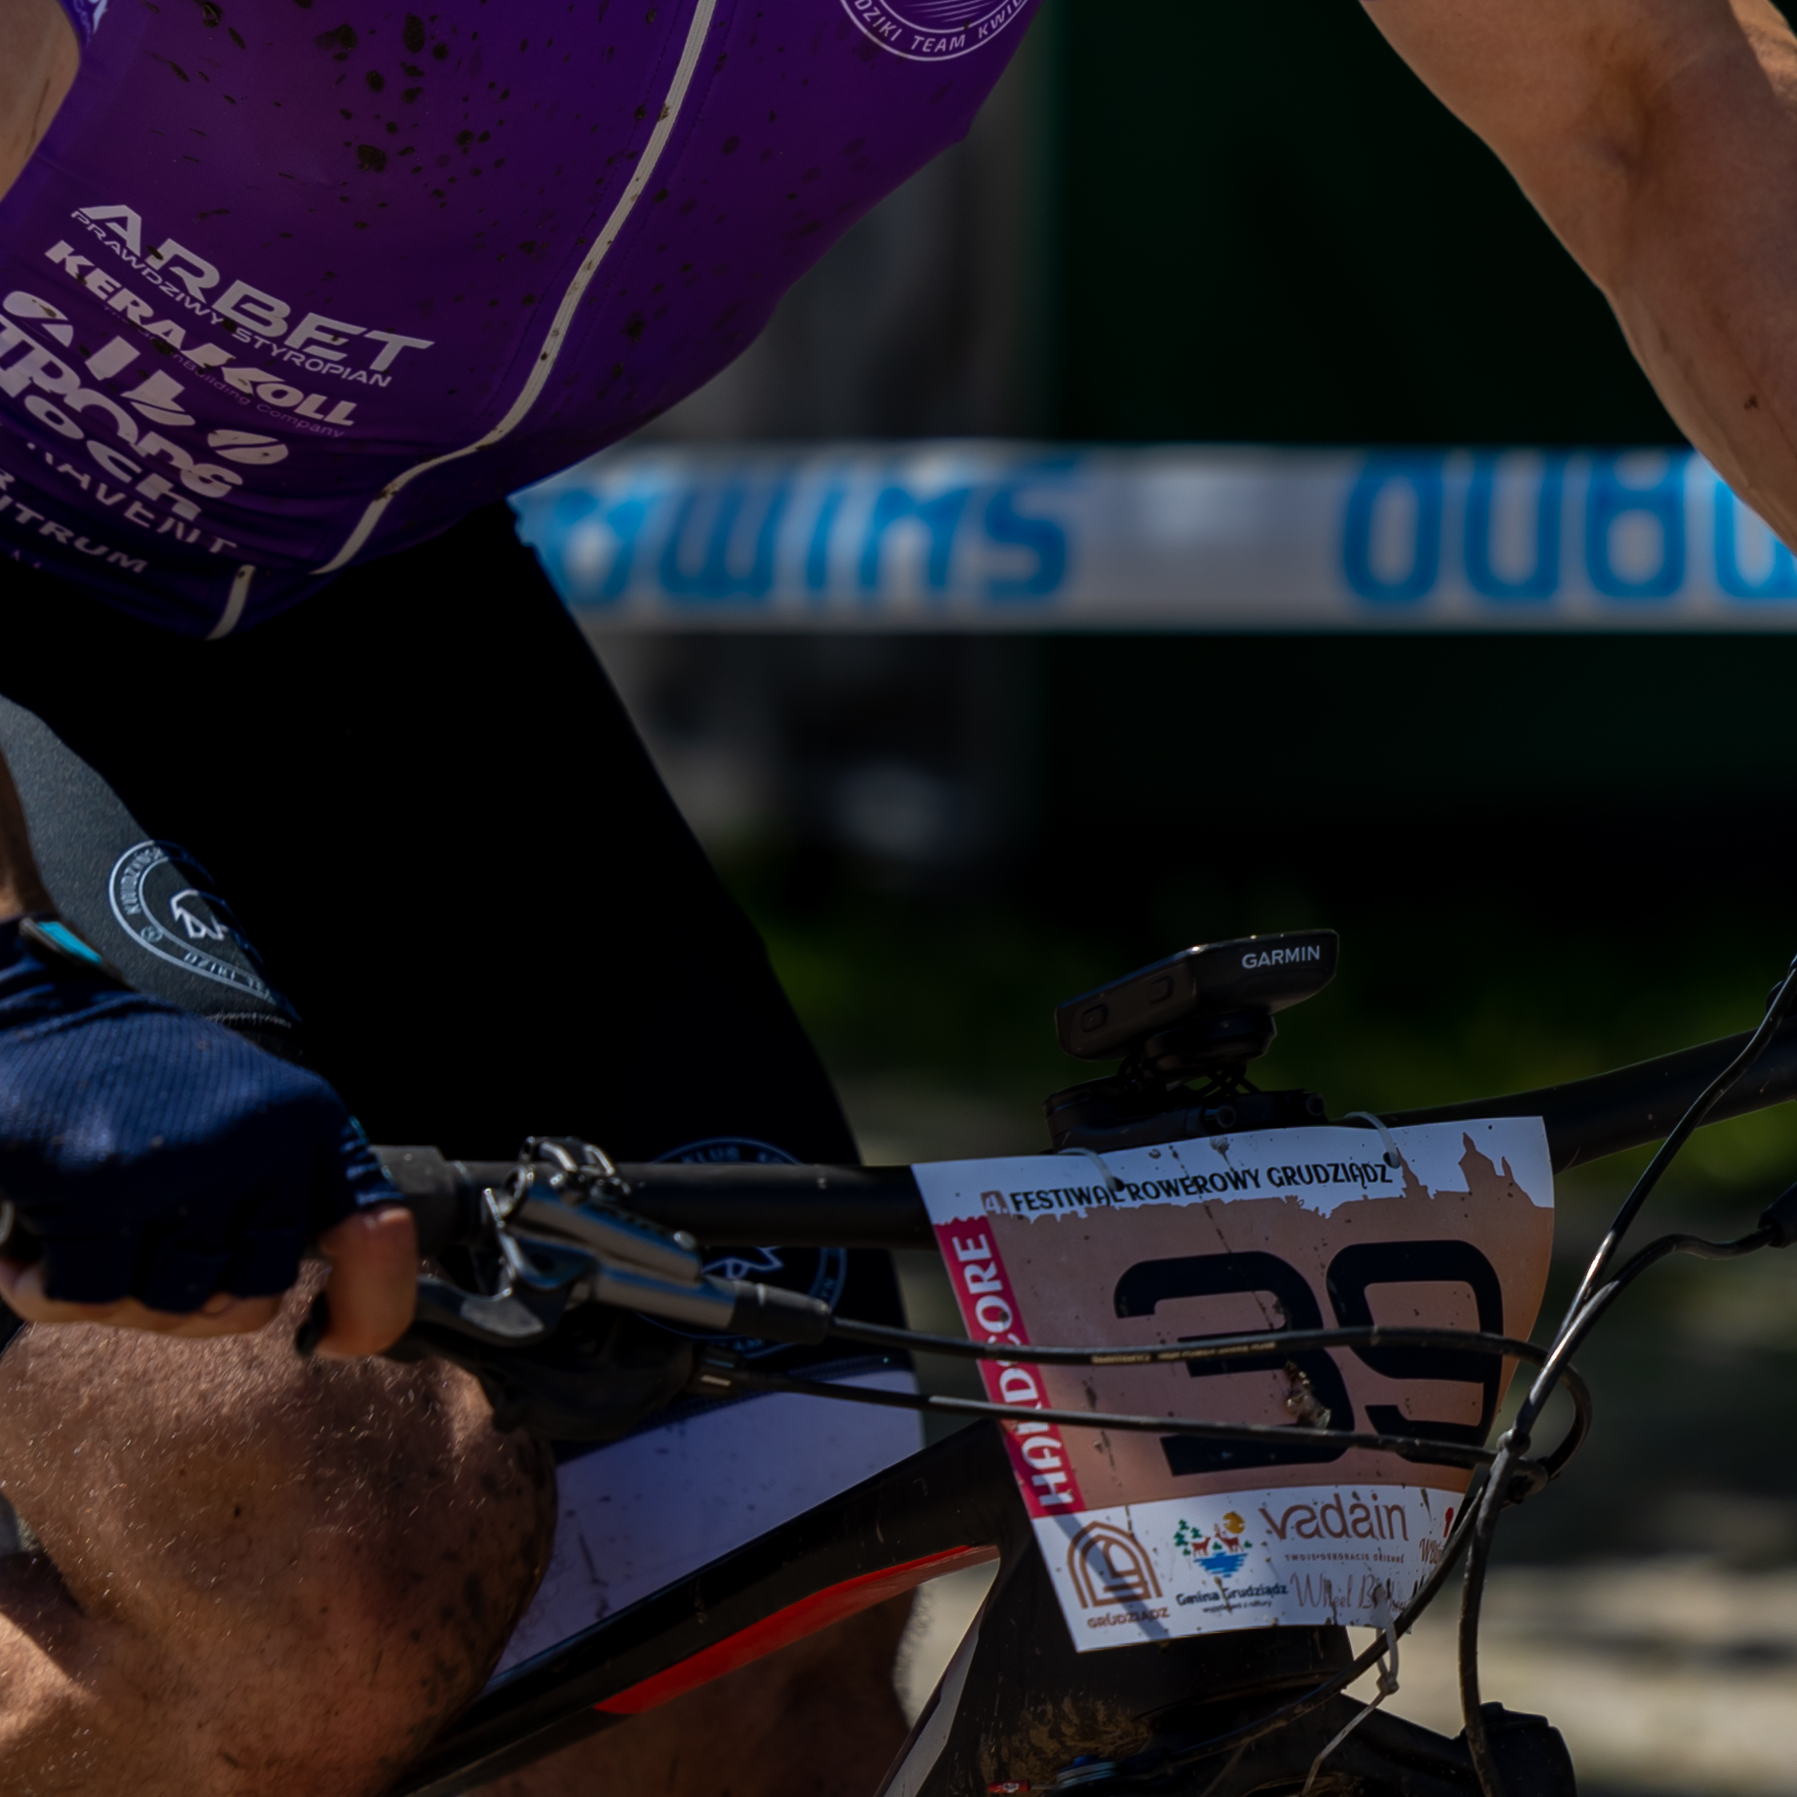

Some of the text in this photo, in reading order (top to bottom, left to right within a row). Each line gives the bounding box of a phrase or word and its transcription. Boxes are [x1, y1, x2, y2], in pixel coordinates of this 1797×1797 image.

[909, 32, 967, 54] TEAM
[44, 239, 360, 427] KERAKOLL
[69, 208, 393, 389] PRAWDZIWY STYROPIAN
[78, 204, 436, 376] ARBET
[256, 400, 346, 440] Company
[1241, 944, 1322, 971] GARMIN
[1011, 1183, 1125, 1211] FESTIWAL
[1126, 1168, 1261, 1203] ROWEROWY
[1267, 1161, 1394, 1190] GRUDZIĄDZ
[1114, 1239, 1505, 1478] 39
